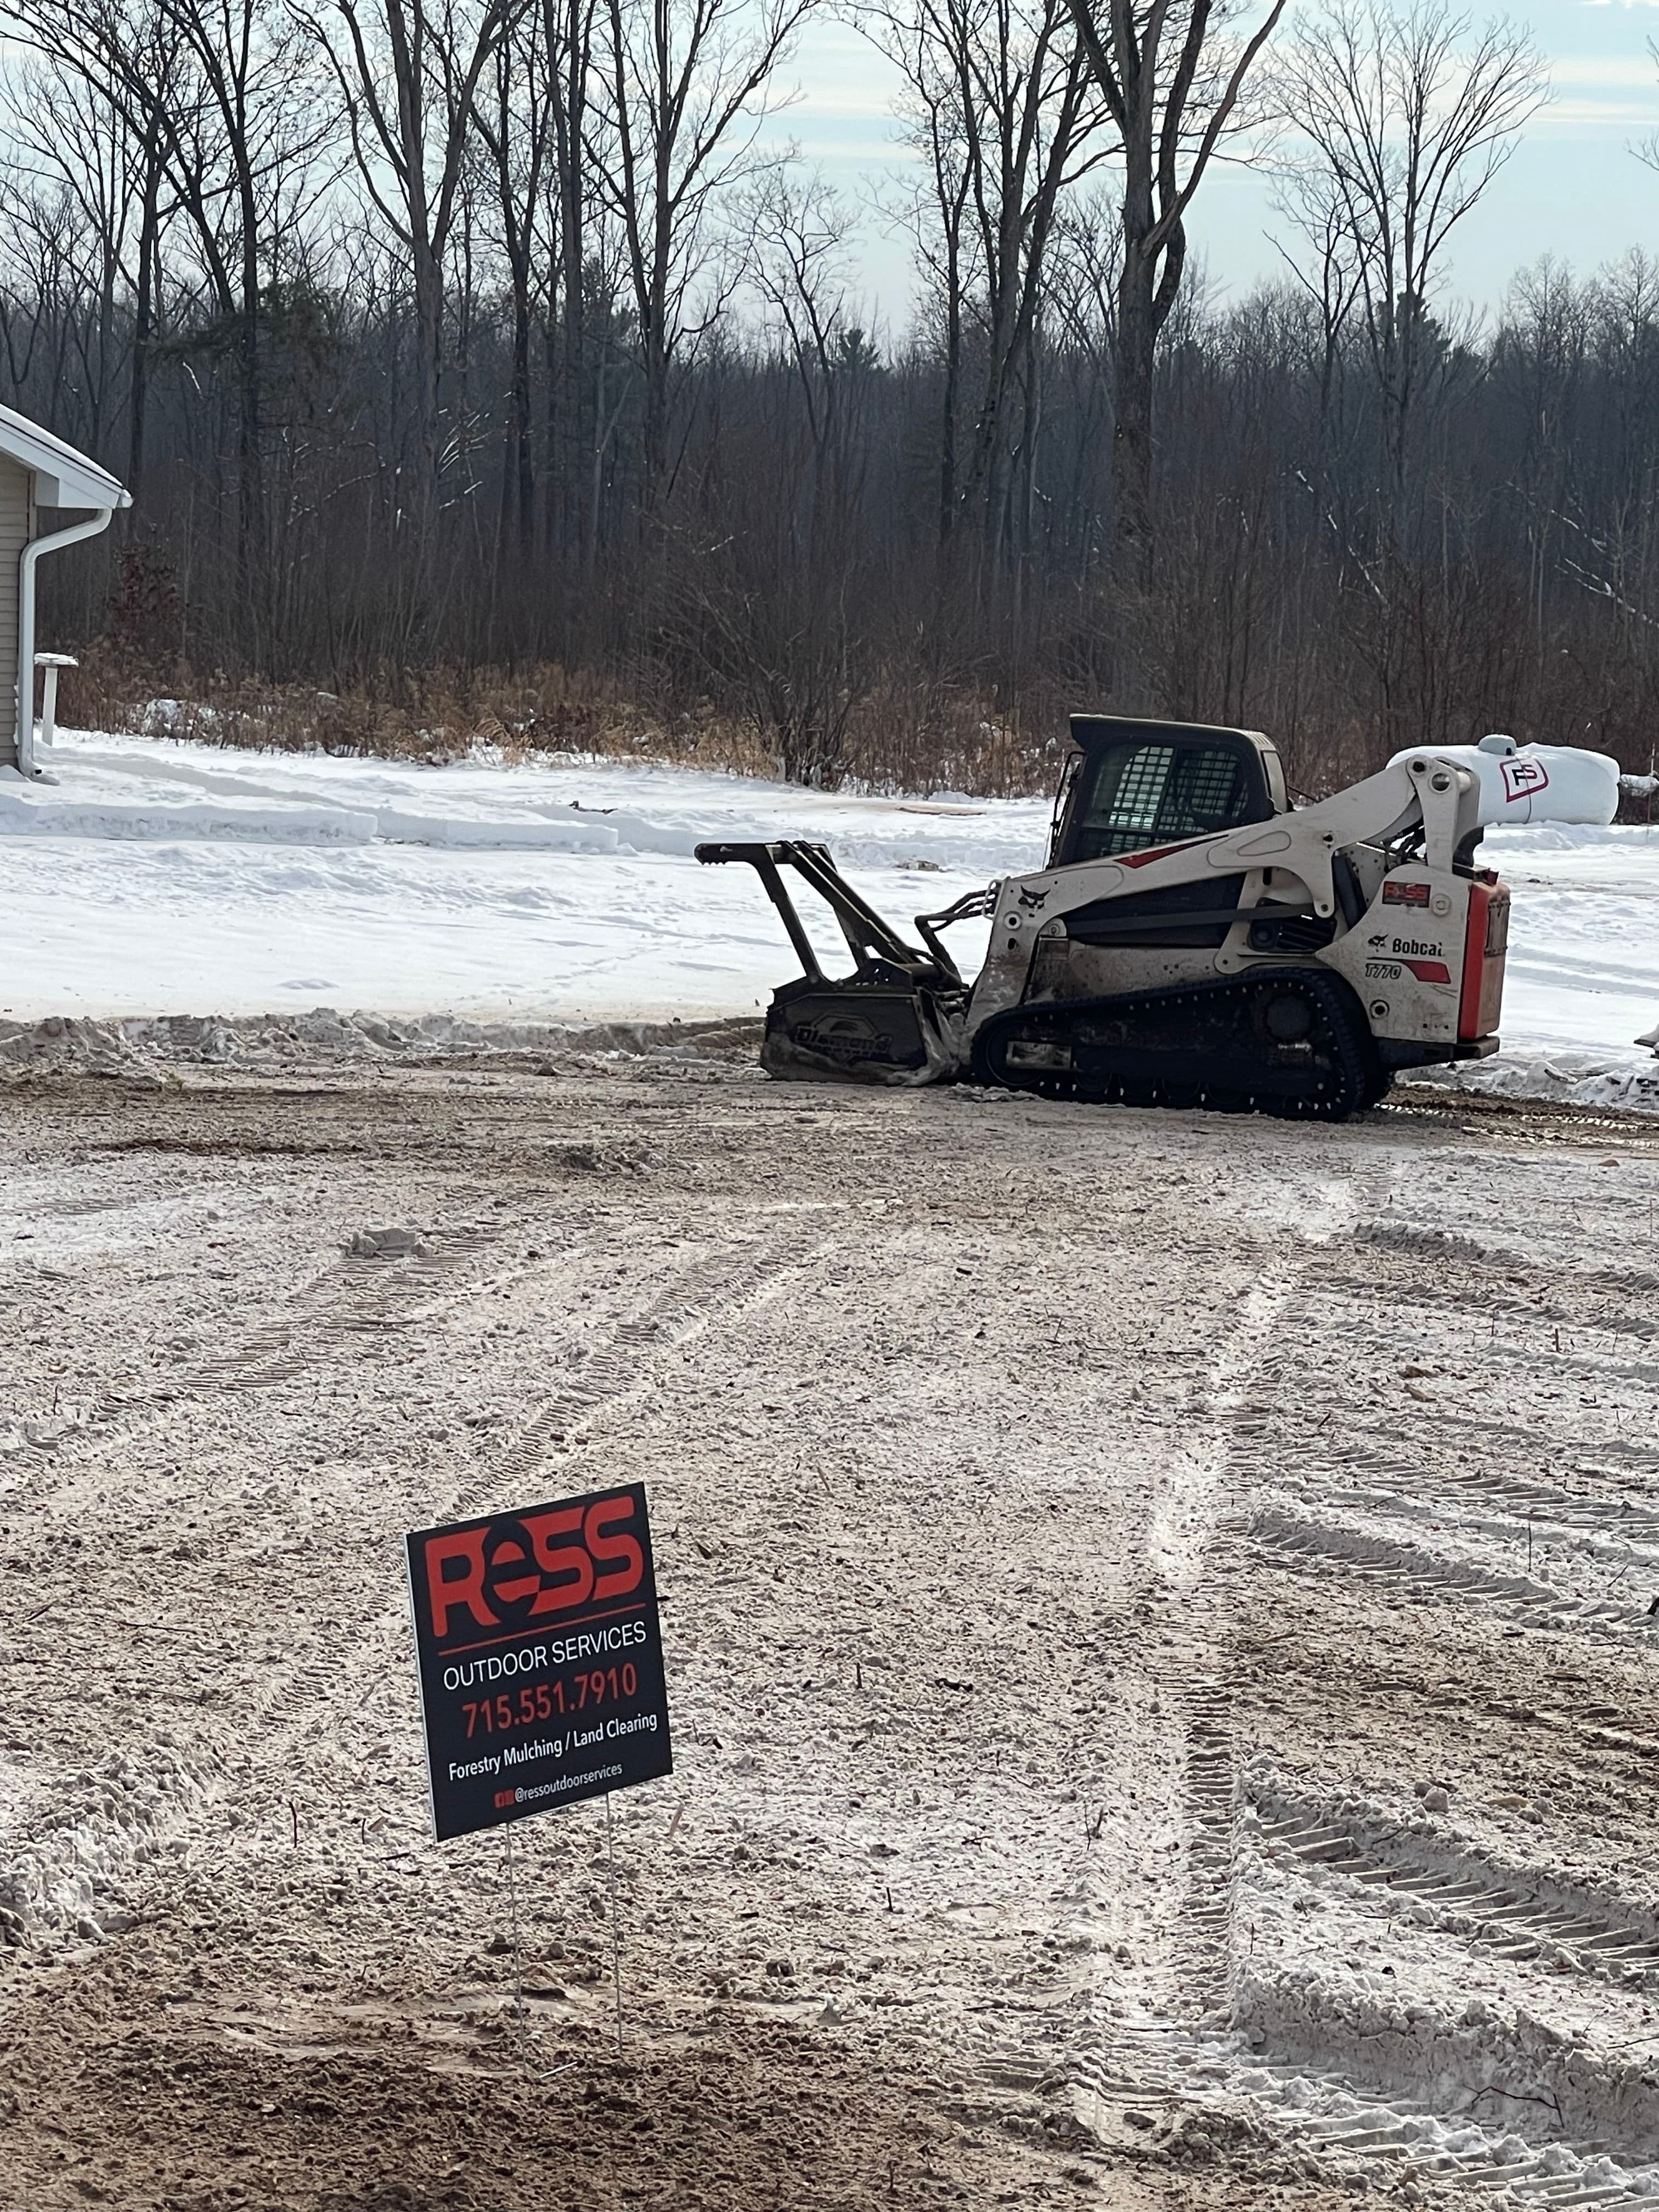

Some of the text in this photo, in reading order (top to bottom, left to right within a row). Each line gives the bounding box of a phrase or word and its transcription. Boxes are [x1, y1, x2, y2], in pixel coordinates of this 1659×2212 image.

[1511, 764, 1537, 786] FS
[1365, 963, 1402, 979] T770
[443, 1621, 646, 1690] OUTDOOR SERVICES
[462, 1663, 637, 1738] 715.551.7910
[449, 1712, 658, 1781] Forestry Mulching / Land Clearing
[515, 1763, 623, 1802] @ressoutdoorservices
